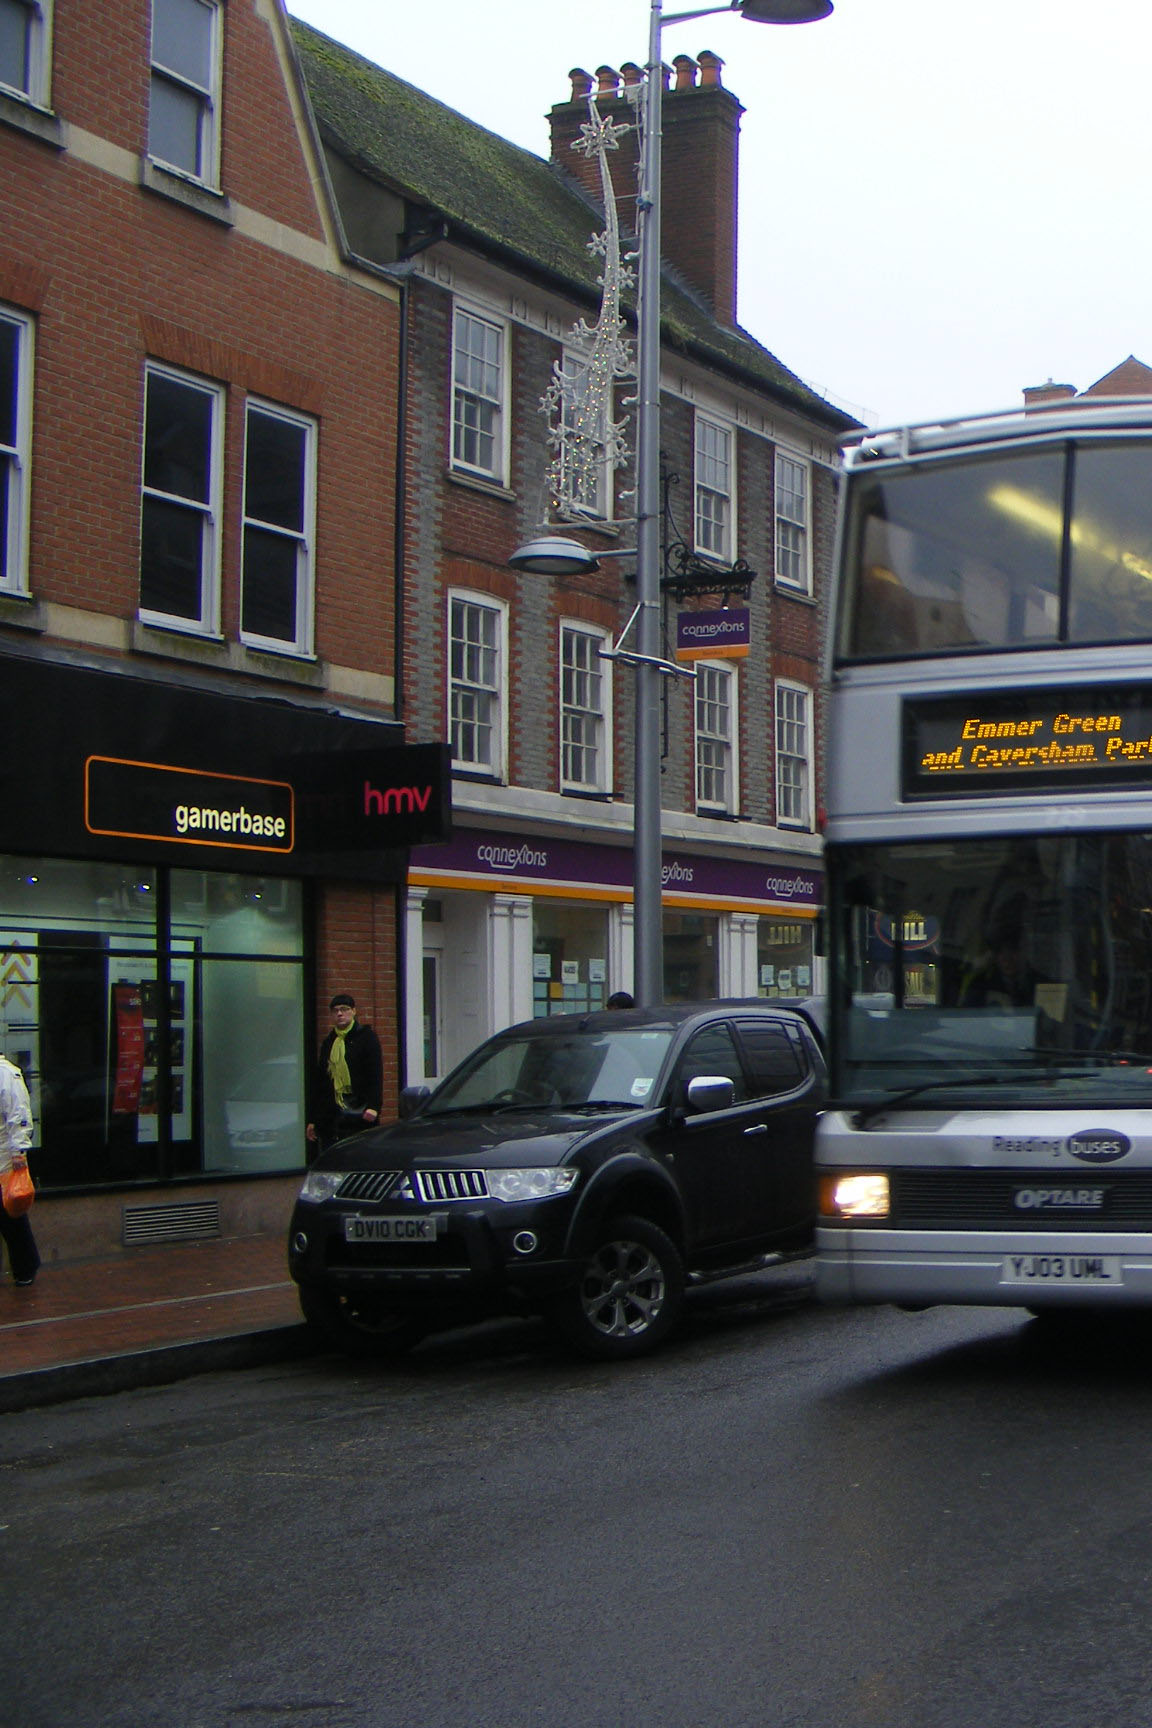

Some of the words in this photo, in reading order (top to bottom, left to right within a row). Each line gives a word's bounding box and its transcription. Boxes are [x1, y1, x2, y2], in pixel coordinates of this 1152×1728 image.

[682, 621, 745, 637] connexions
[961, 719, 1043, 739] Emmer
[1053, 714, 1121, 733] Green
[921, 747, 965, 770] and
[970, 741, 1098, 767] Caversham
[364, 781, 432, 816] hmv
[175, 805, 286, 838] gamerbase
[477, 844, 547, 869] connexions
[766, 876, 813, 896] connexions
[993, 1135, 1062, 1157] Reading
[1070, 1137, 1121, 1154] buses
[1015, 1189, 1104, 1208] OPTARE
[1010, 1257, 1066, 1278] YJ03
[1070, 1257, 1111, 1279] UML
